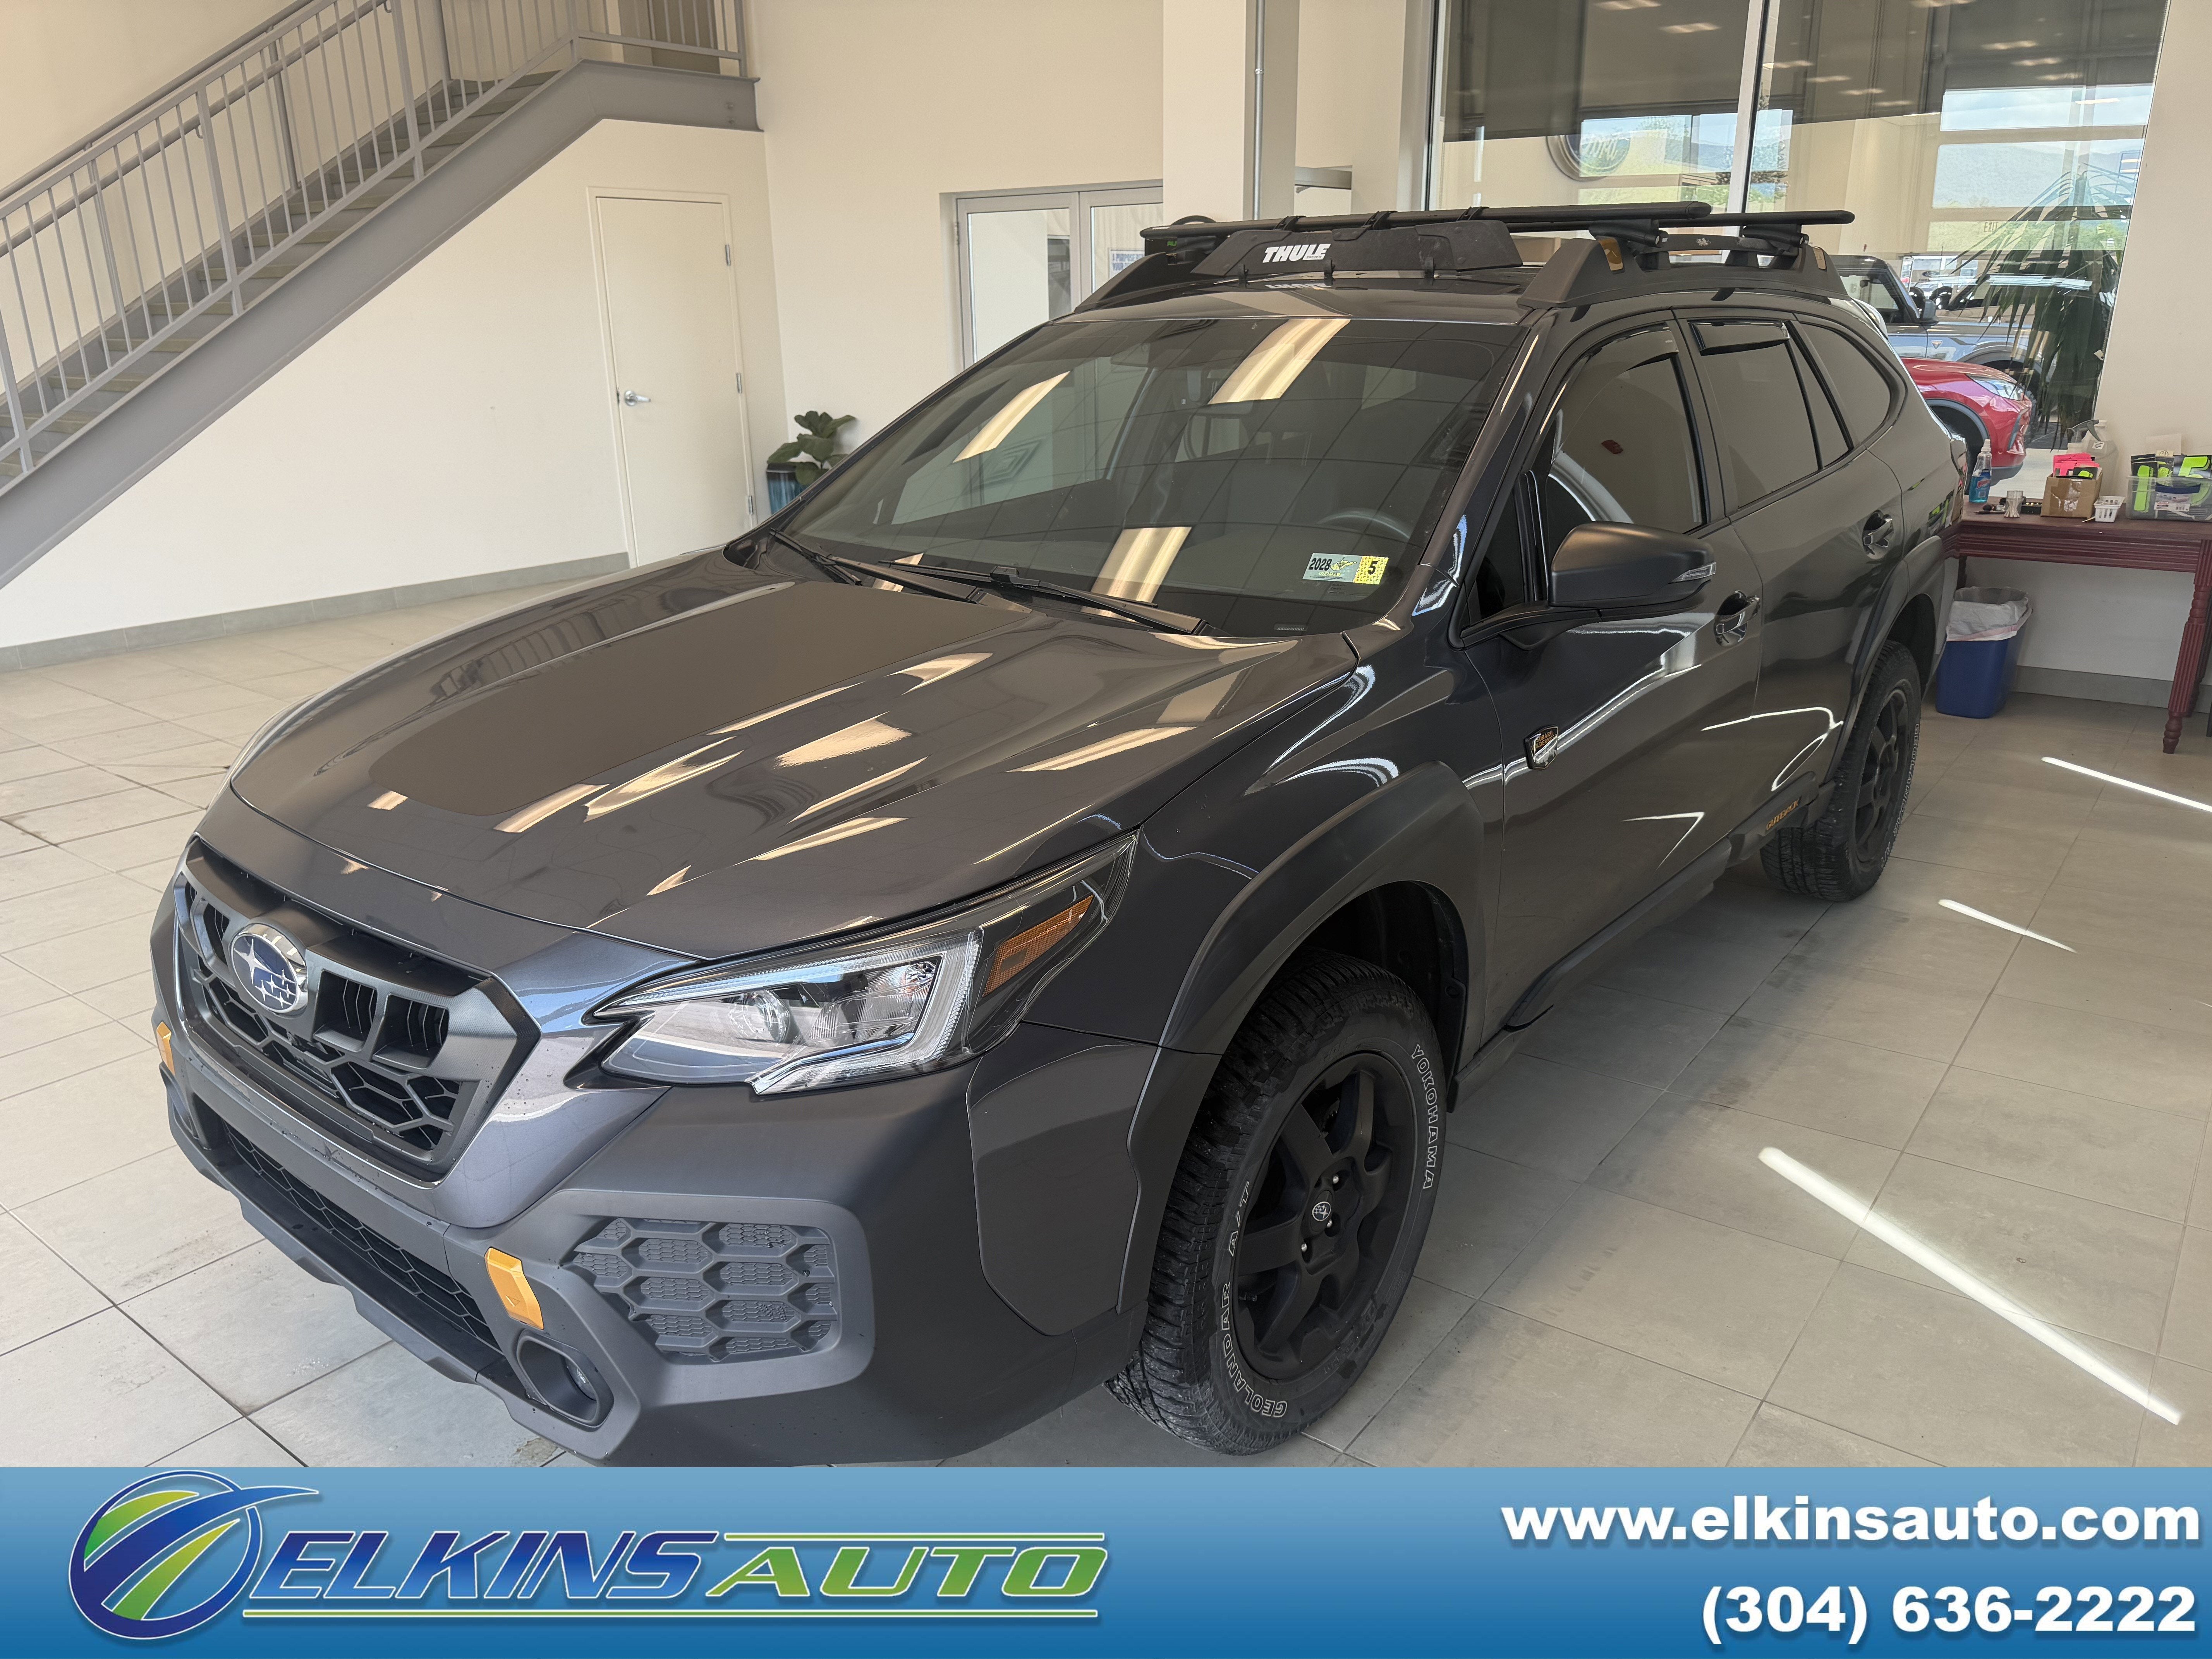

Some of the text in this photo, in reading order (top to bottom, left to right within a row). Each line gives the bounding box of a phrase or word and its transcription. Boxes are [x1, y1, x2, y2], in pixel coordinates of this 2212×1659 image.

[1984, 222, 1999, 232] EXIT
[1262, 244, 1331, 263] THULE
[1309, 558, 1332, 571] 2028
[1367, 560, 1378, 575] 5
[1535, 730, 1553, 743] SUBARU
[1766, 799, 1799, 830] OUTBACK
[1410, 1043, 1437, 1190] YOKOHAMA
[1221, 1181, 1288, 1419] GEOLANDAR A/T
